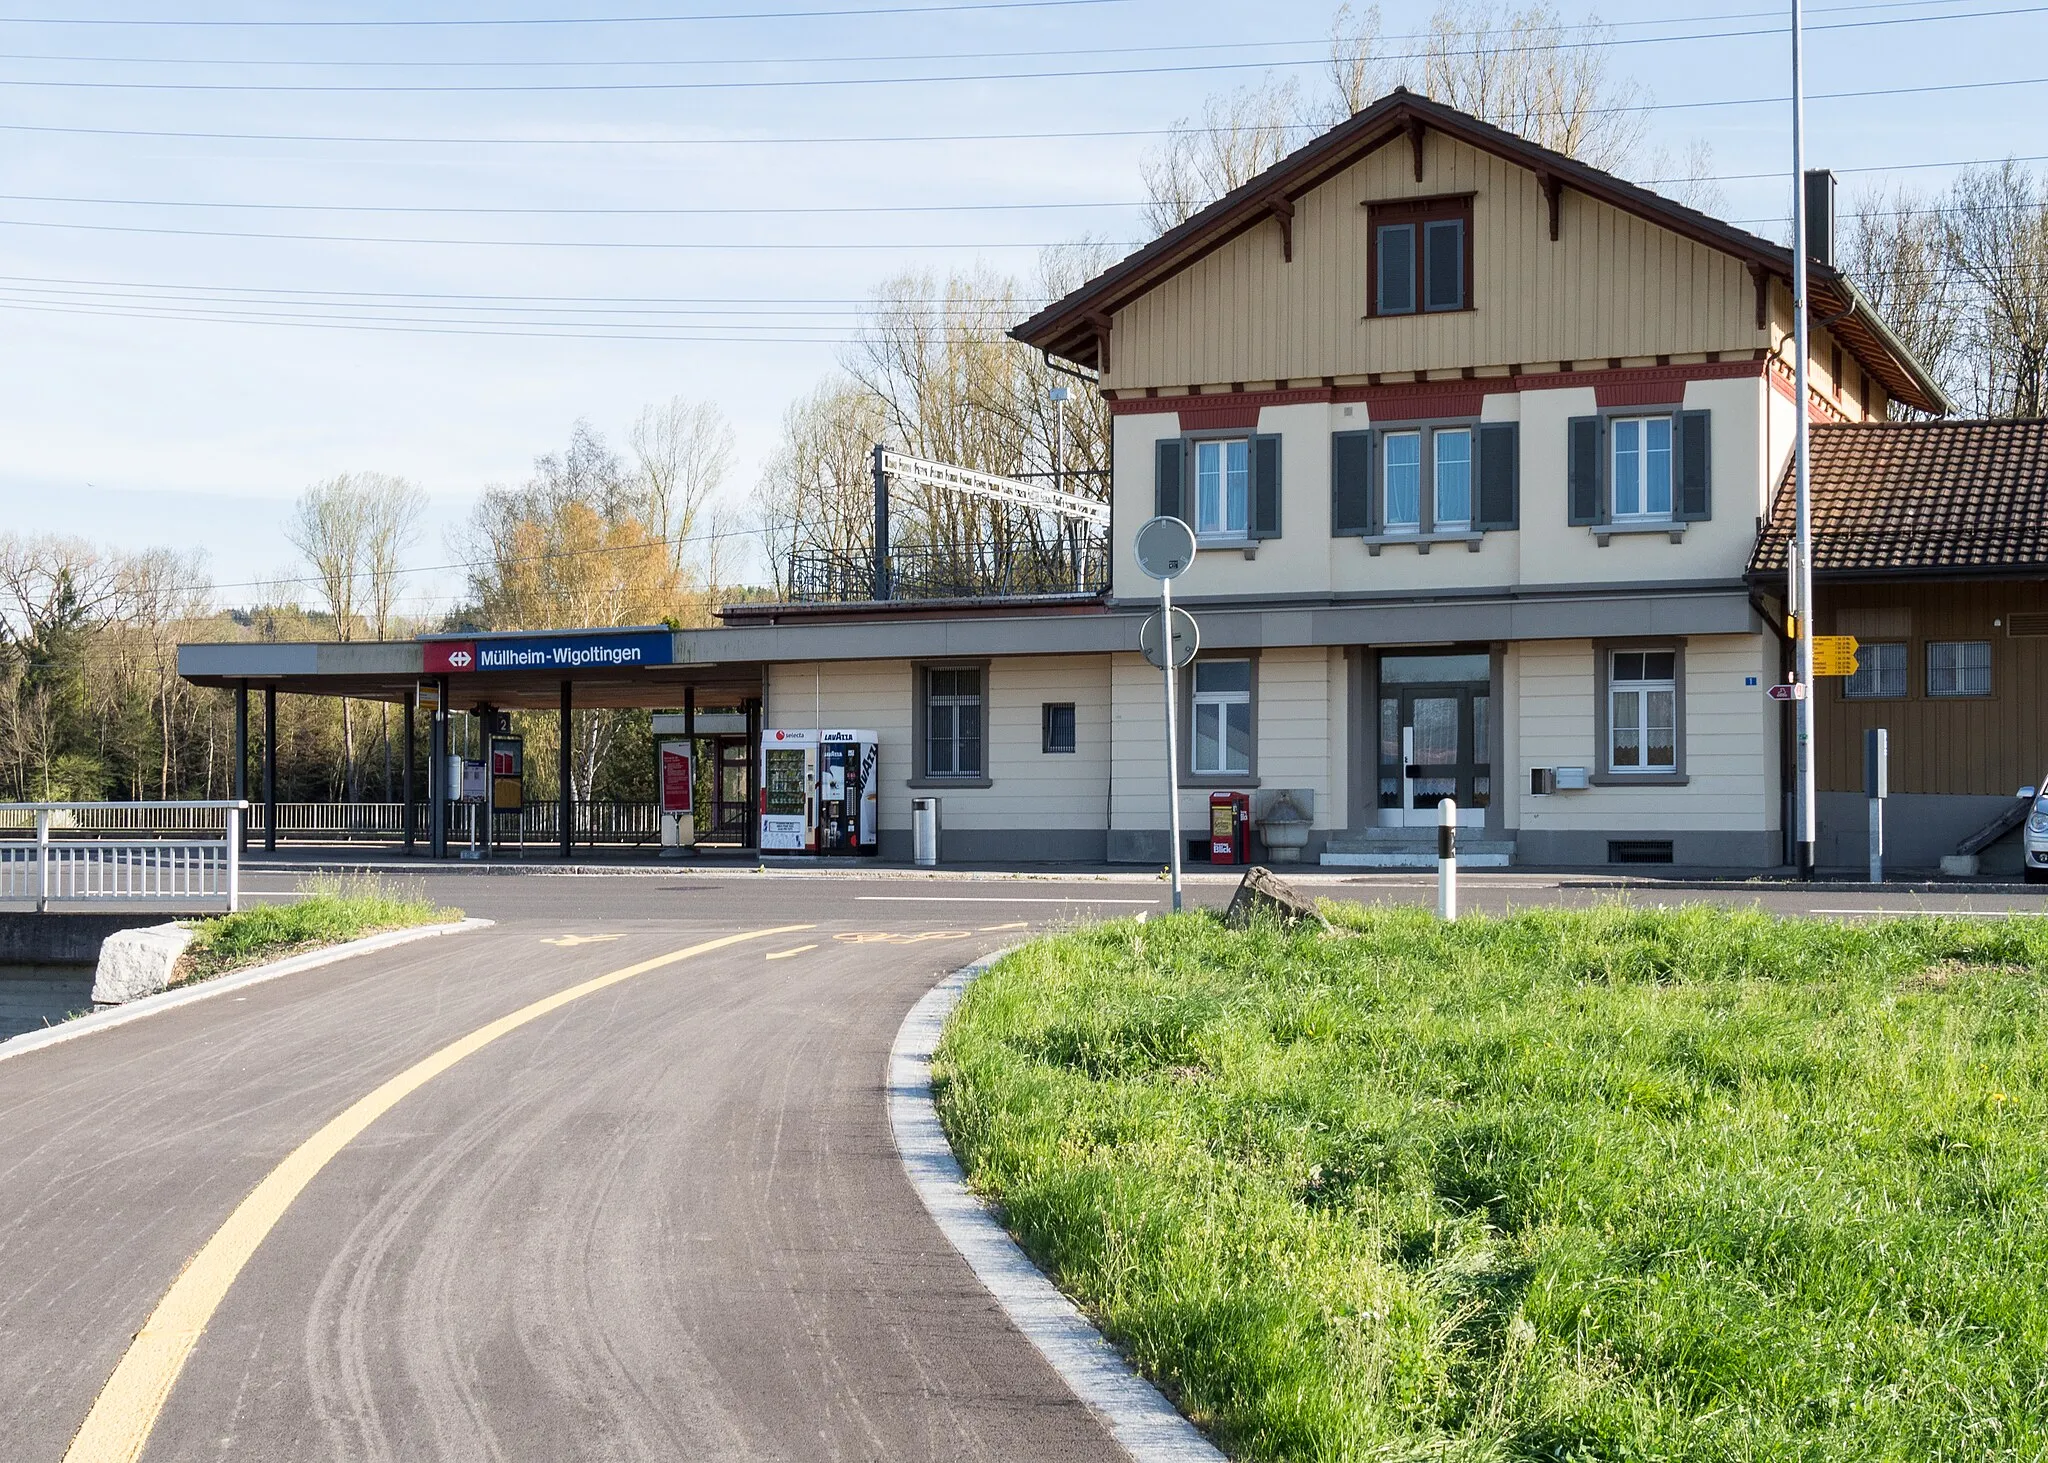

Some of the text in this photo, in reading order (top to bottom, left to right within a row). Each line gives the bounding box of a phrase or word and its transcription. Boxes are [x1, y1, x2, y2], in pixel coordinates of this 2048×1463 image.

[481, 646, 641, 666] Müllheim-Wigoltingen
[500, 719, 507, 731] 2
[785, 730, 804, 739] selecta
[824, 732, 853, 741] LAVAZZA
